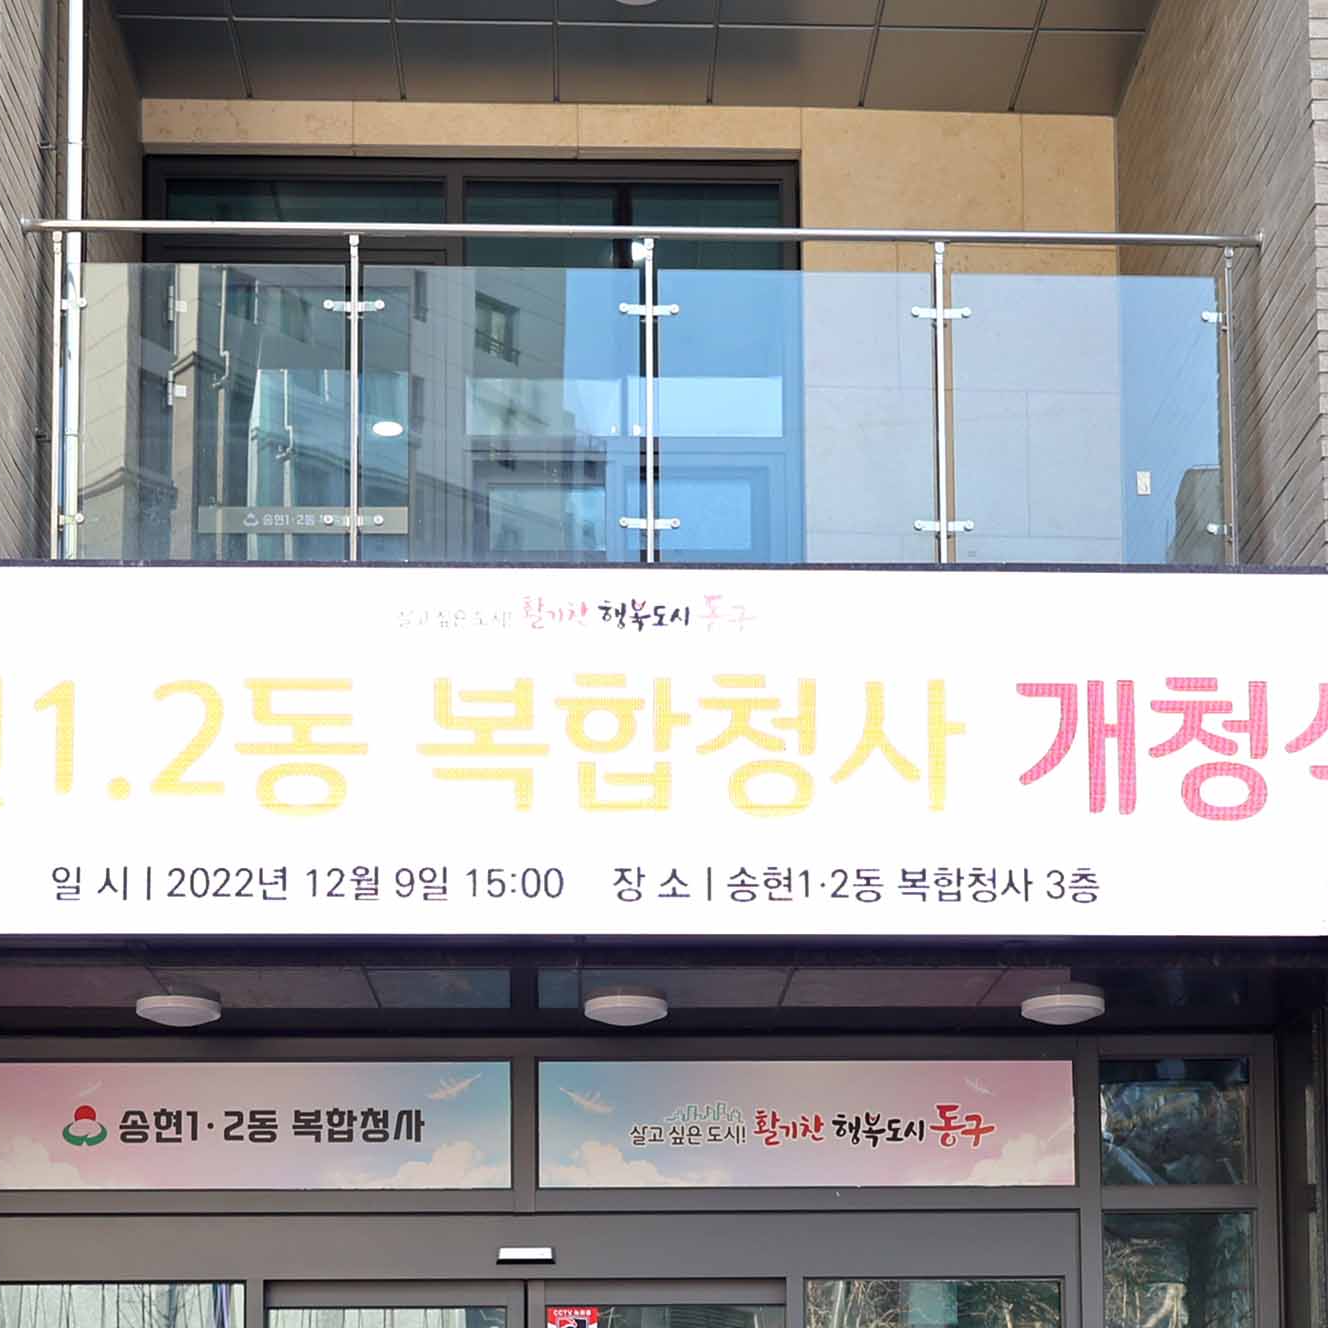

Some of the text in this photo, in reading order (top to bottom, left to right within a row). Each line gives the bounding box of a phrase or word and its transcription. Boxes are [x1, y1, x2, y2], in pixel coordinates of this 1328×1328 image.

[597, 598, 691, 632] 행복도시
[417, 673, 966, 817] 복합청사
[167, 866, 287, 901] 2022년
[306, 866, 380, 901] 12월
[396, 866, 448, 901] 9일
[469, 867, 564, 898] 15:00
[727, 866, 884, 903] 송현1·2동
[897, 866, 1033, 903] 복합청사
[1047, 866, 1100, 903] 3층
[119, 1107, 425, 1144] 송현1·2동 복합청사
[629, 1104, 995, 1149] 살고 싶은 도시! 활기찬 행복도시 동구
